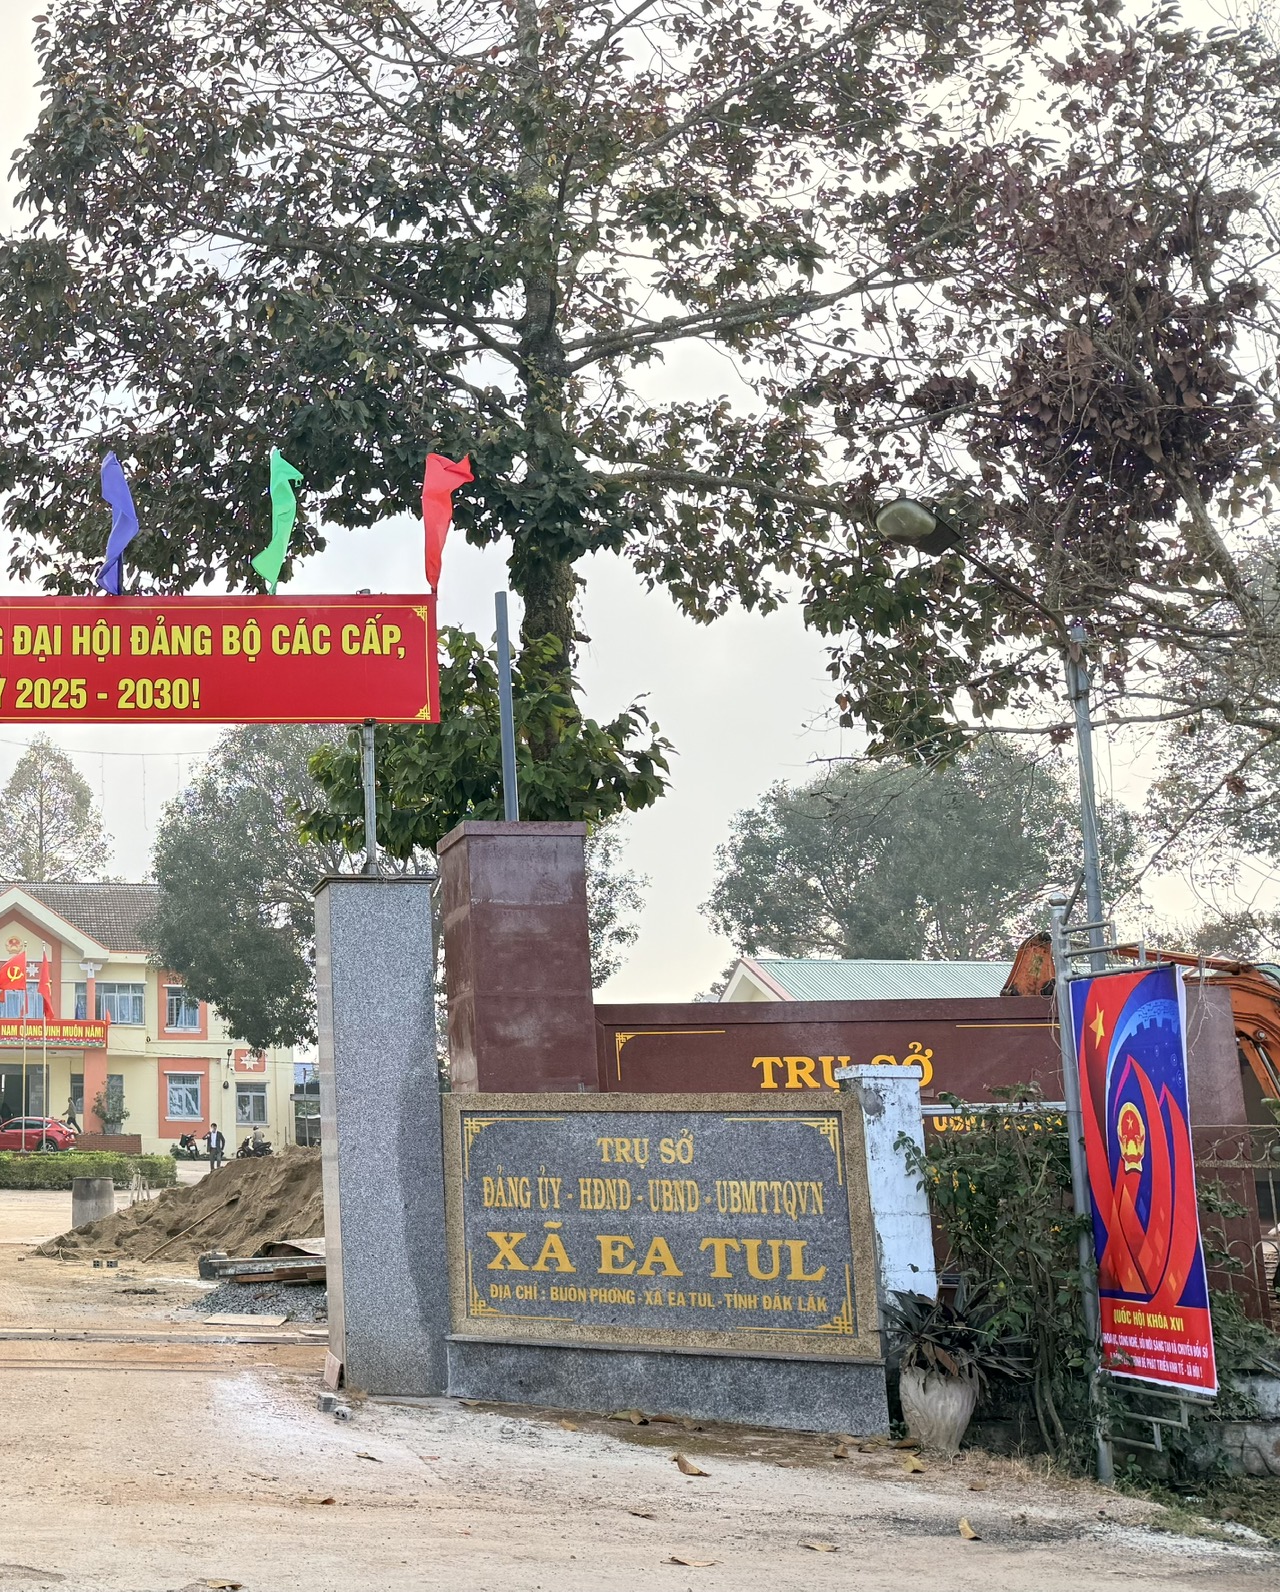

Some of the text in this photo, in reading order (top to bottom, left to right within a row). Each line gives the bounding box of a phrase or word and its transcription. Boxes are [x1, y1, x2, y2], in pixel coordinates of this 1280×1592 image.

[12, 624, 62, 662] ĐẠI
[72, 619, 120, 662] HỘI
[130, 615, 212, 656] ĐẢNG
[222, 619, 262, 662] BỘ
[271, 618, 331, 656] CÁC
[341, 613, 405, 660] CẤP,
[15, 678, 87, 710] 2025
[97, 690, 108, 700] -
[117, 678, 201, 710] 2030!
[1, 1025, 18, 1036] NAM
[20, 1025, 42, 1037] QUANG
[45, 1025, 60, 1037] VINH
[751, 1041, 934, 1094] TRỤ Ở
[597, 1128, 694, 1169] TRỤ SỞ
[483, 1165, 531, 1209] ĐẢNG
[538, 1165, 562, 1209] ỦY
[579, 1178, 631, 1210] HĐND
[648, 1180, 700, 1213] UBND
[716, 1180, 823, 1221] UBMTTQVN
[486, 1220, 827, 1281] XÃ EA TUL
[490, 1284, 511, 1301] ĐỊA
[550, 1284, 587, 1302] BUÔN
[644, 1287, 663, 1306] XÃ
[669, 1291, 686, 1308] EA
[689, 1291, 716, 1308] TUL
[724, 1288, 758, 1309] TỈNH
[1133, 1309, 1145, 1329] HỘI
[1169, 1317, 1184, 1332] XVI
